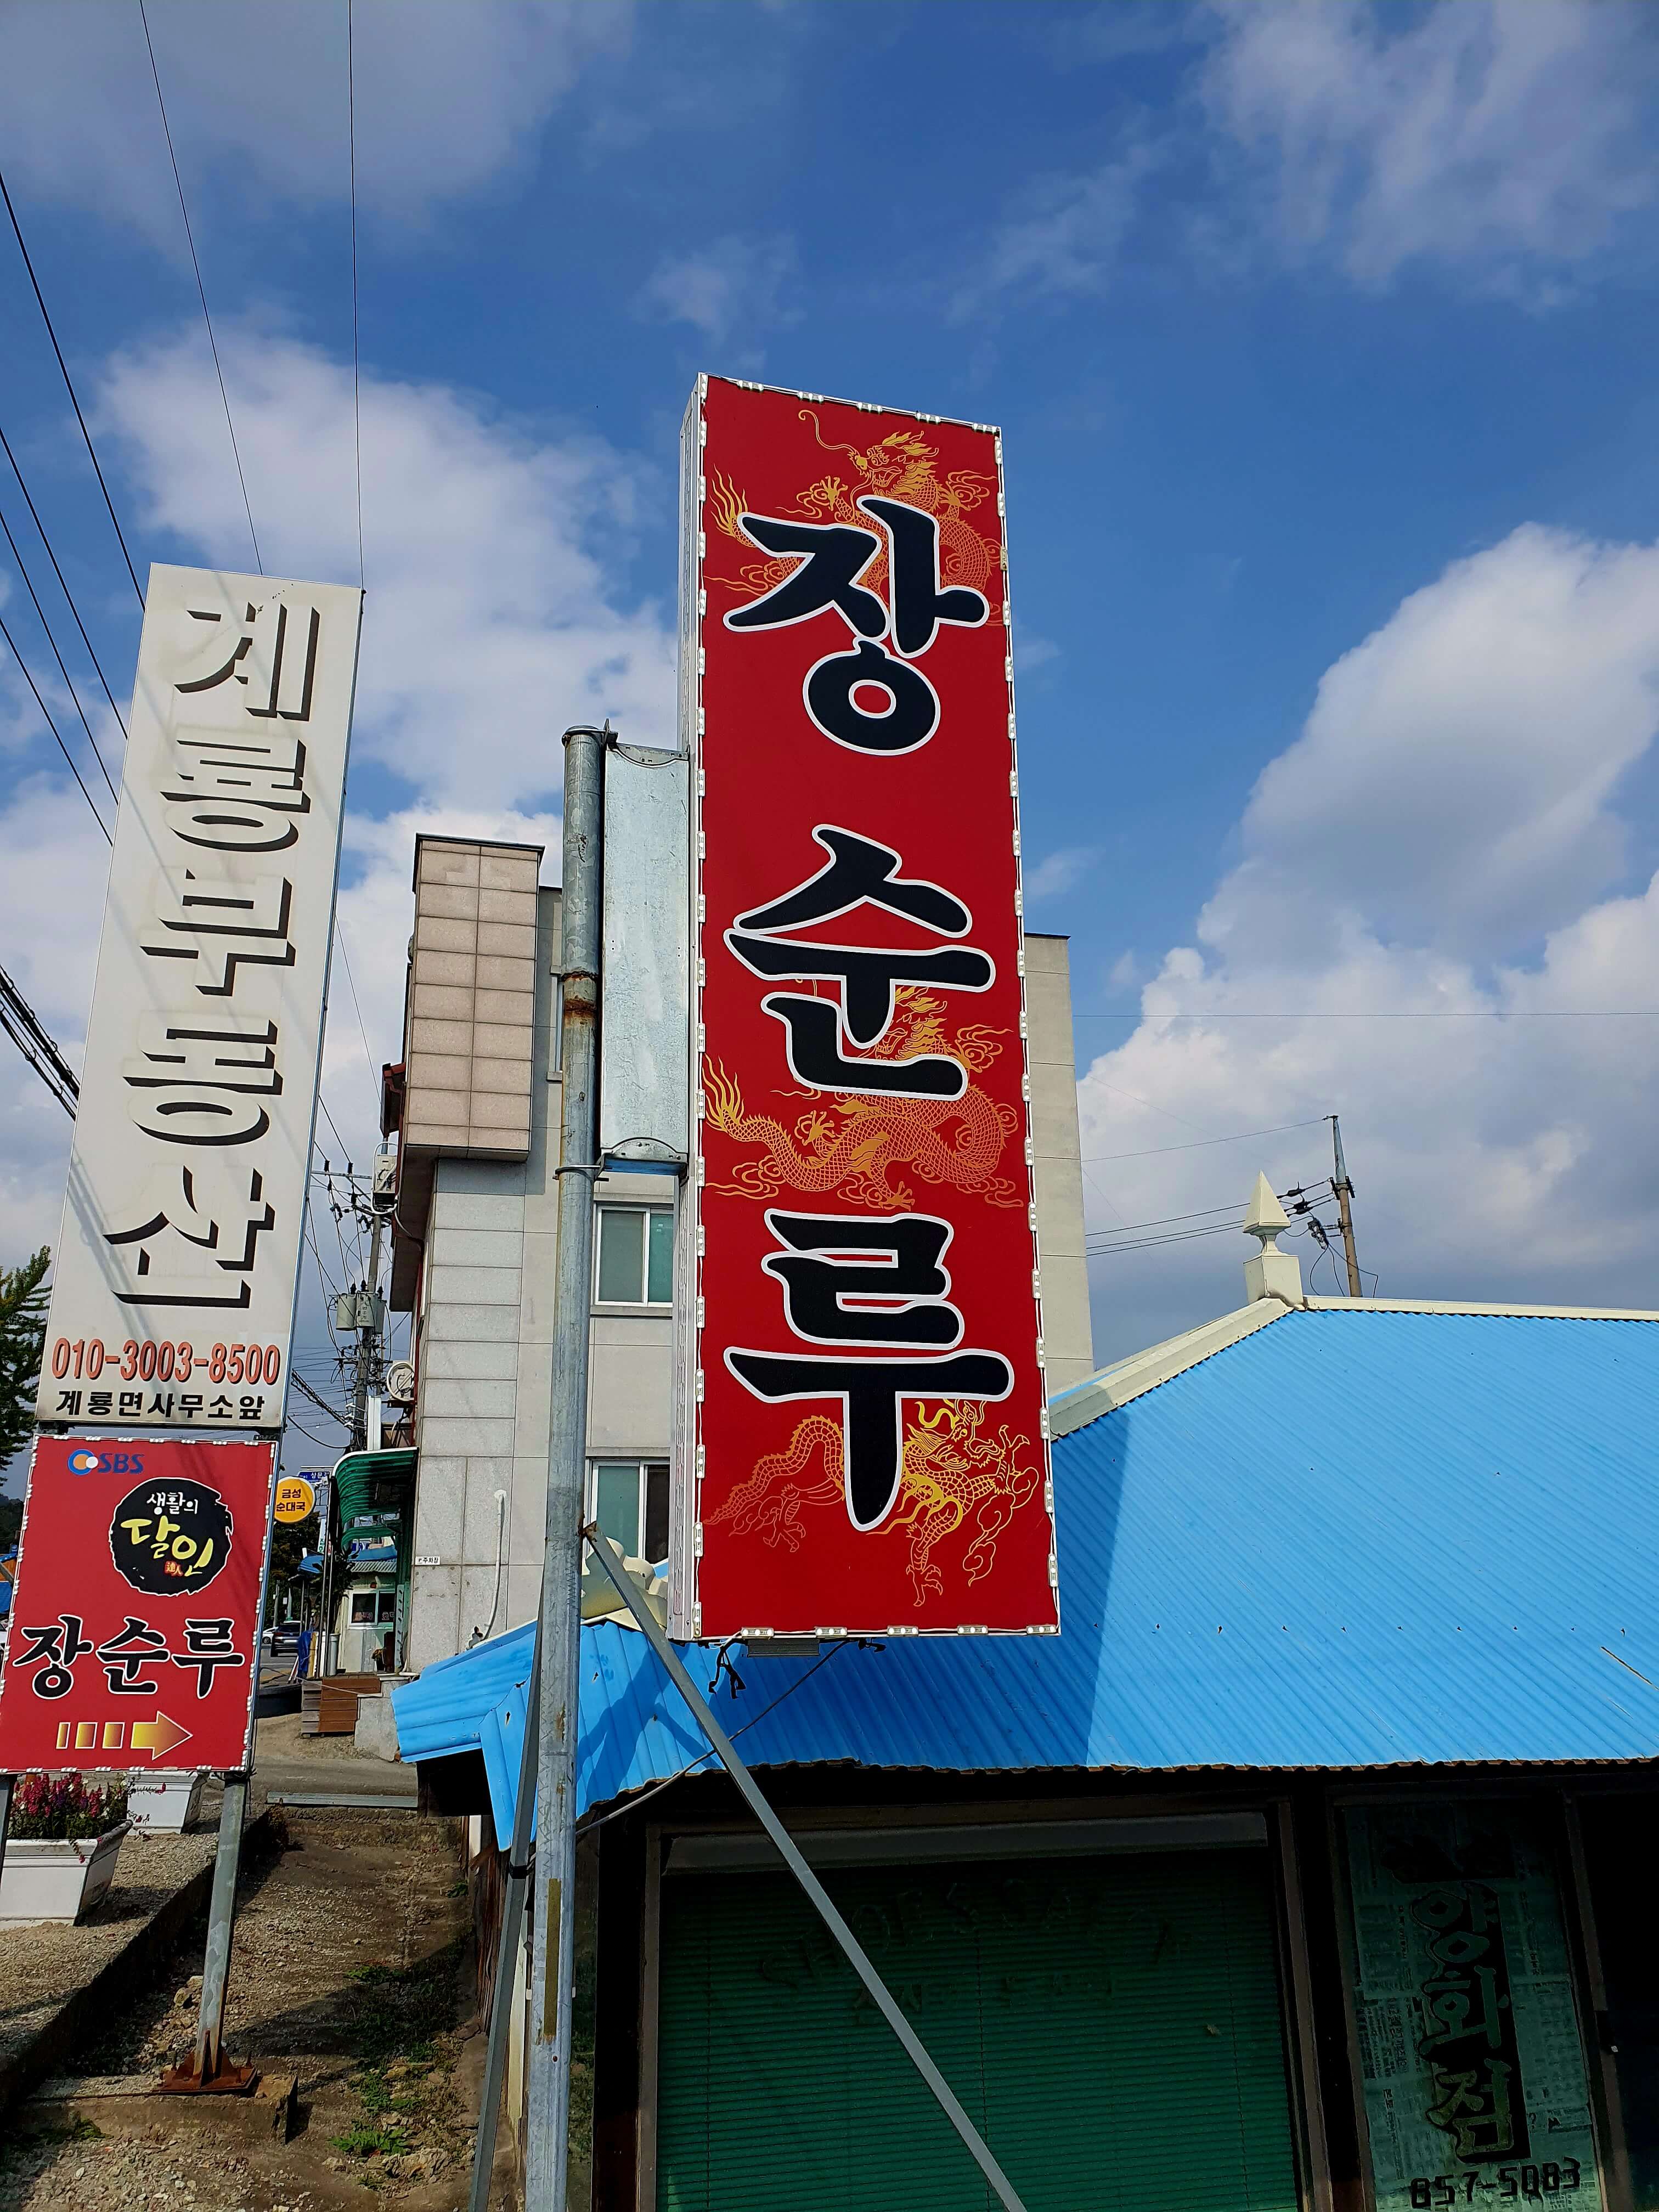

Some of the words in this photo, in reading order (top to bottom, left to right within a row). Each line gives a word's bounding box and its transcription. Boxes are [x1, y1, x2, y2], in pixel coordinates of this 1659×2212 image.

[102, 600, 320, 1309] 계룡부동산
[724, 495, 1015, 1533] 장순루
[53, 1339, 280, 1384] 010-3003-8500
[56, 1389, 266, 1420] 계룡면사무소앞
[97, 1452, 145, 1474] SBS
[146, 1492, 199, 1515] 생활의
[276, 1502, 306, 1512] 순대국
[282, 1488, 302, 1499] 금성
[120, 1515, 214, 1577] 달인
[13, 1615, 245, 1700] 장순루
[1413, 1883, 1521, 2158] 양화점
[1412, 2158, 1581, 2209] 857-5083
